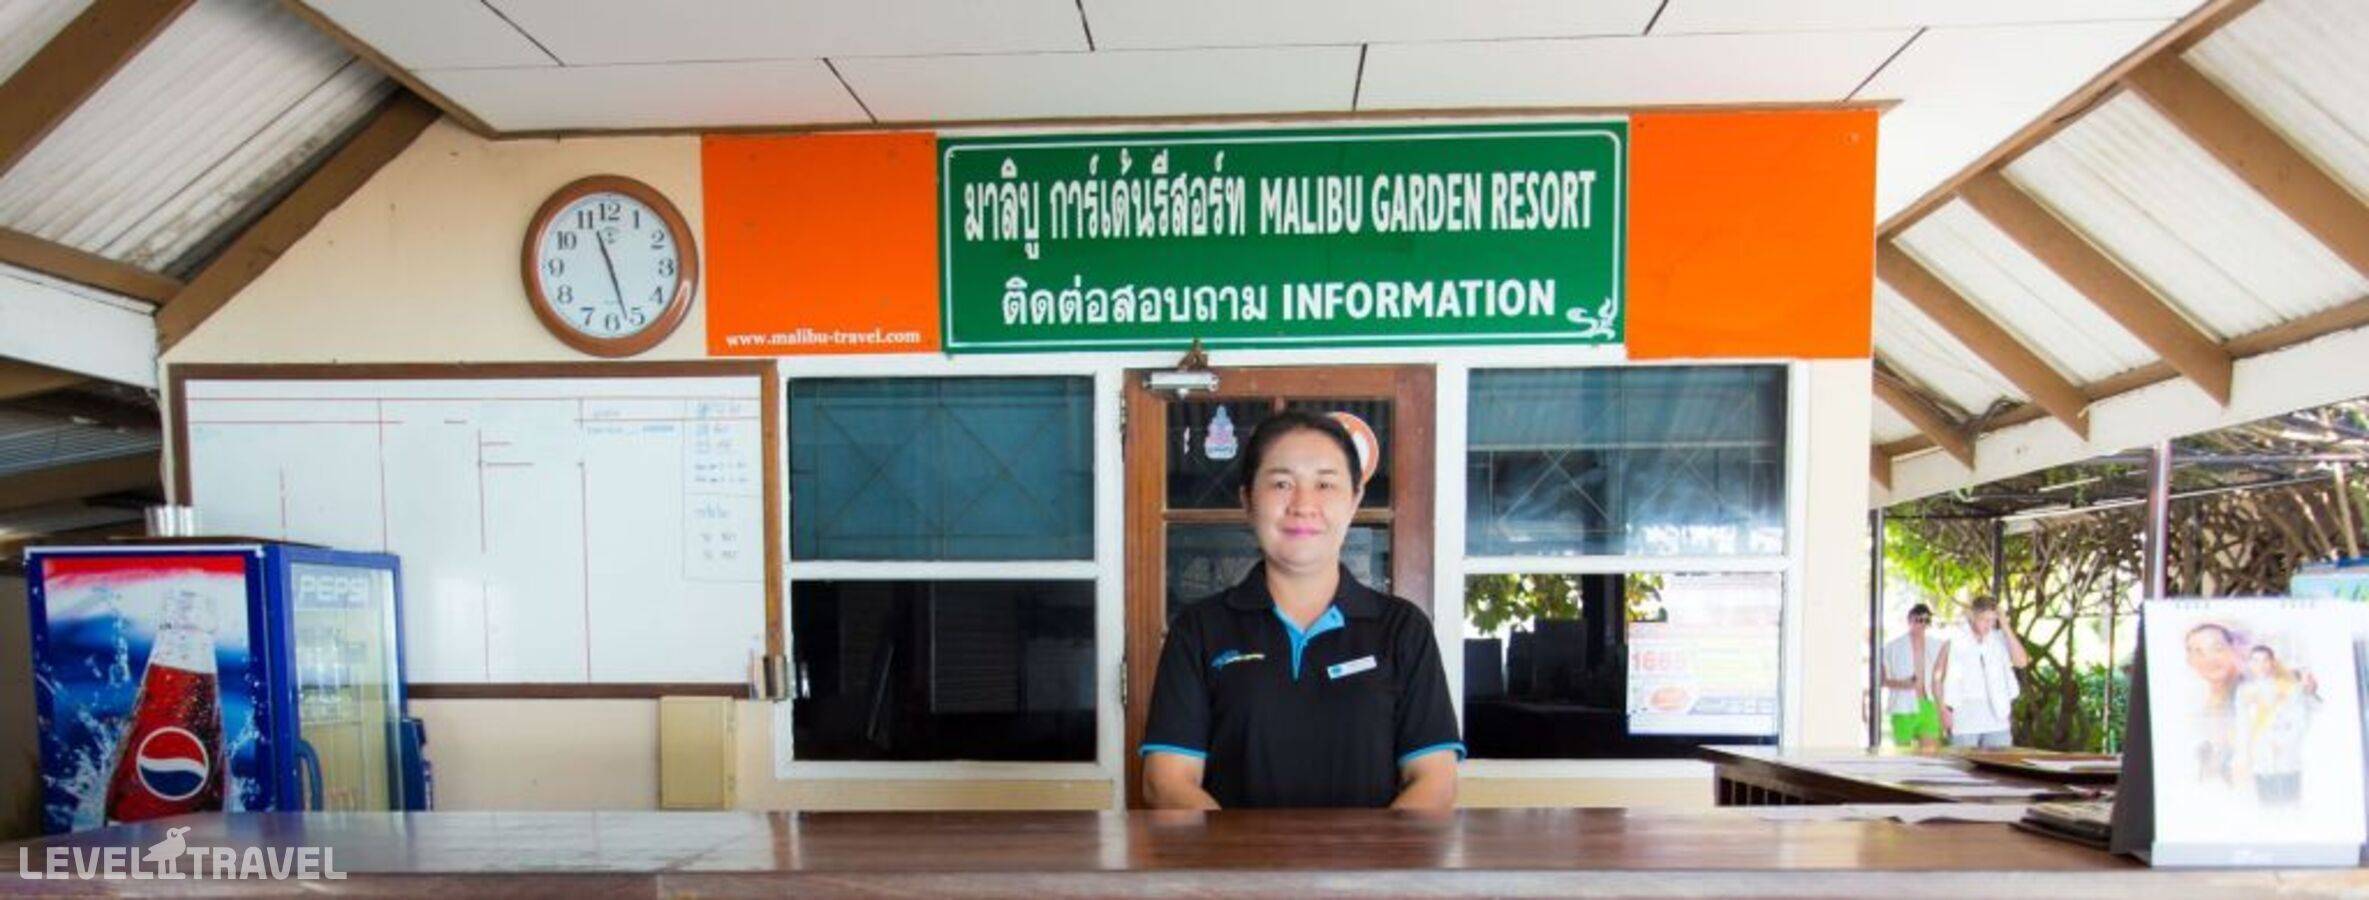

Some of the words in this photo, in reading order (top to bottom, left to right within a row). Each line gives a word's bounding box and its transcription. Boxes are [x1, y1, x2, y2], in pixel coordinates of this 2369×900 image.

[599, 202, 621, 221] 12
[964, 157, 1040, 260] มาลิบู
[1259, 174, 1363, 236] MALIBU
[1371, 172, 1482, 233] GARDEN
[1491, 170, 1596, 230] RESORT
[578, 210, 594, 229] 11
[633, 210, 641, 229] 1
[557, 231, 577, 250] 10
[650, 229, 665, 249] 2
[548, 259, 564, 276] 9
[658, 259, 674, 276] 3
[557, 284, 573, 304] 8
[650, 286, 664, 304] 4
[1003, 275, 1267, 325] ติดต่อสอบถาม
[1283, 279, 1555, 321] INFORMATION
[580, 307, 595, 326] 7
[604, 313, 621, 331] 6
[629, 307, 646, 326] 5
[726, 328, 921, 347] www.malibu-travel.com
